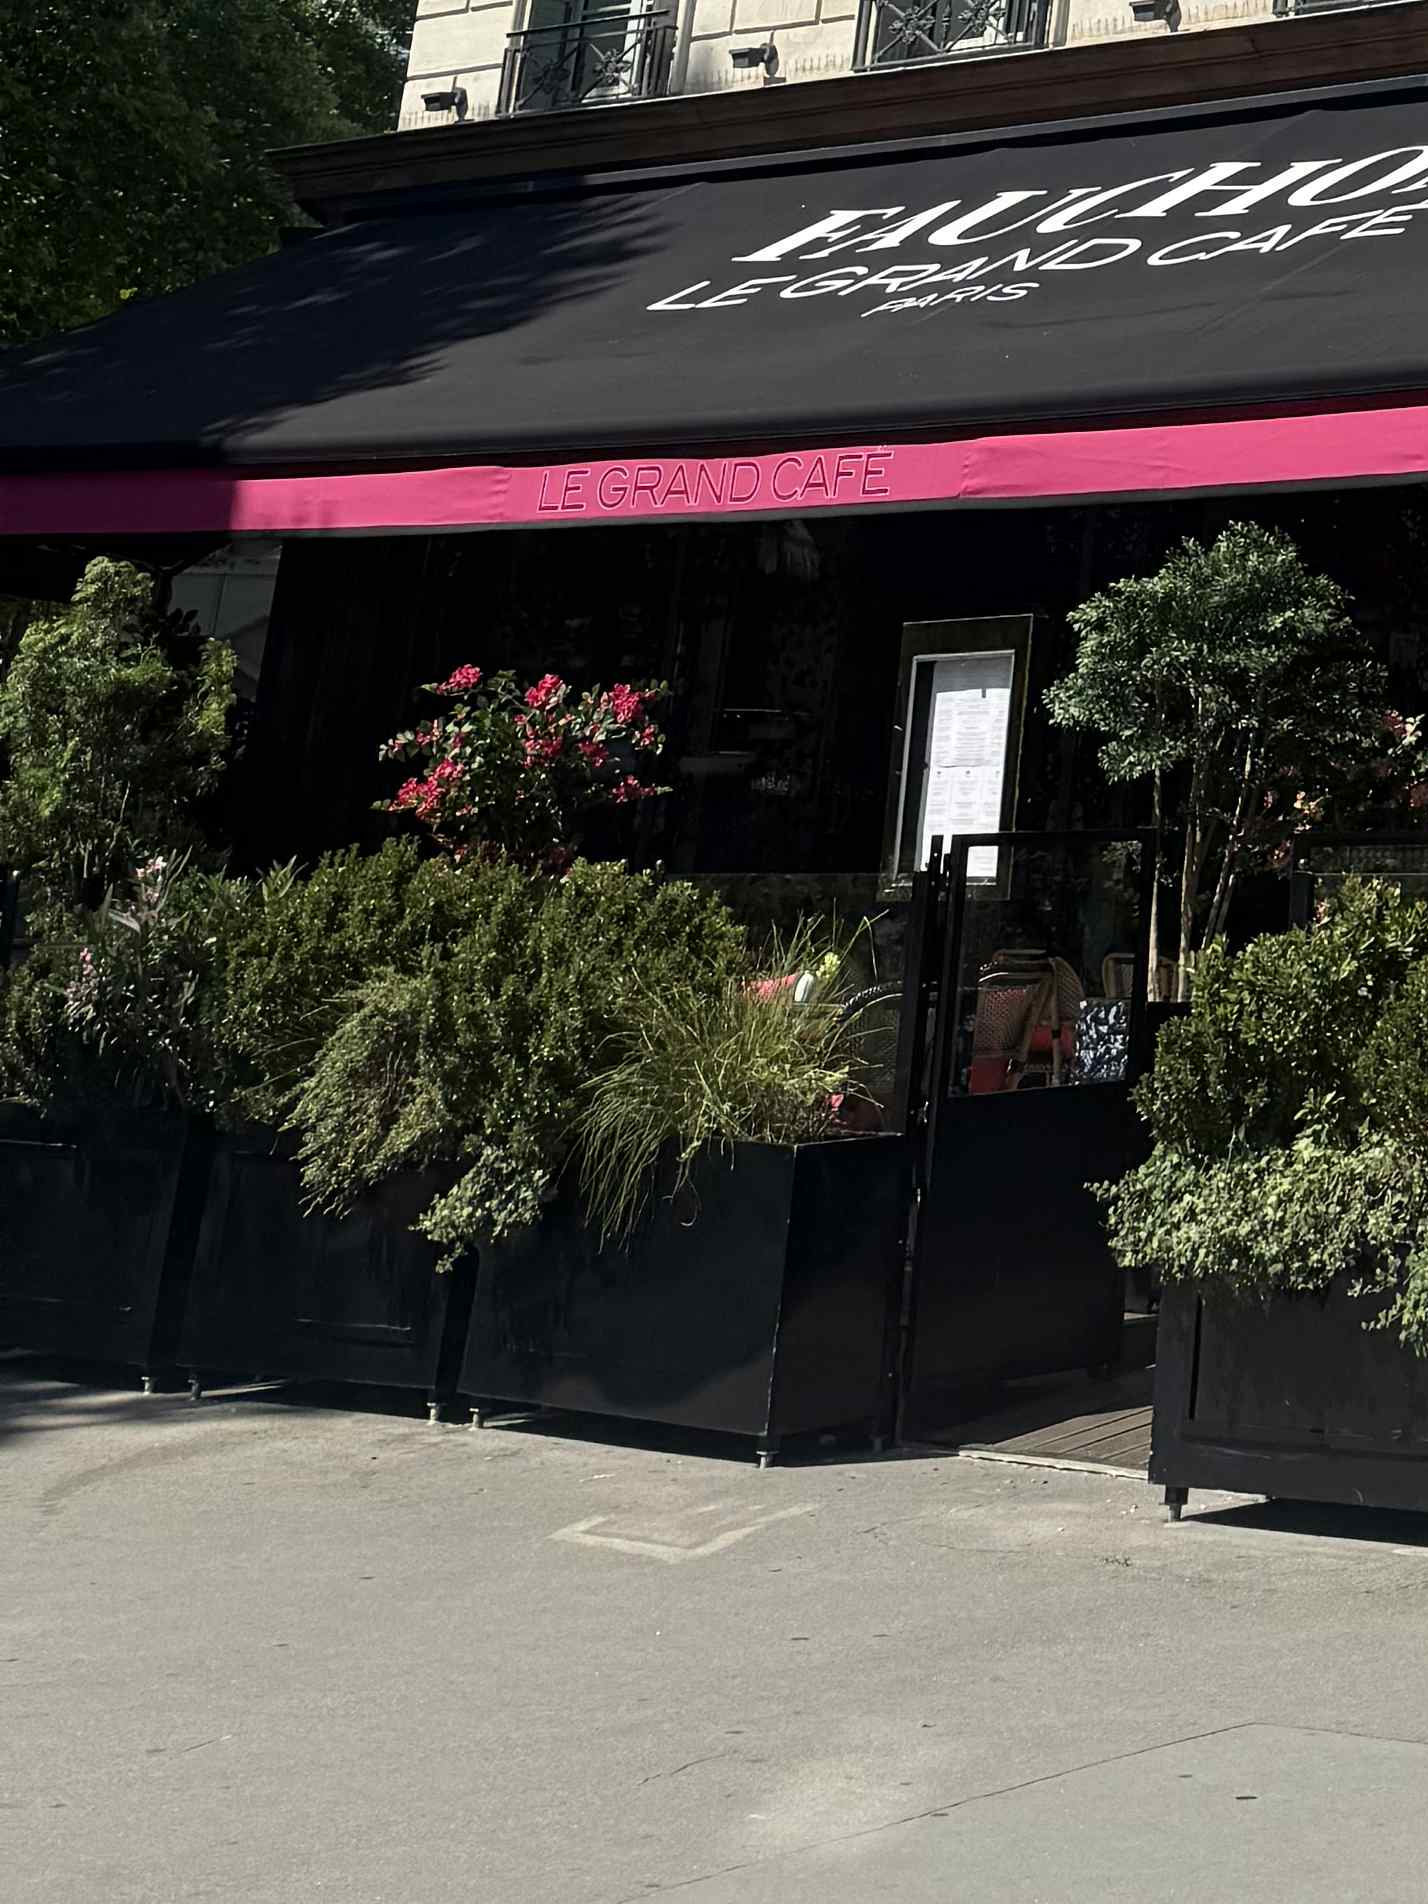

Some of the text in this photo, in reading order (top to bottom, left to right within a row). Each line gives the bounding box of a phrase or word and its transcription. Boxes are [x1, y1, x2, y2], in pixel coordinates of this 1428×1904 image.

[646, 274, 797, 310] LE
[779, 238, 1143, 299] GRAND
[860, 282, 1040, 318] PARIS
[536, 467, 592, 512] LE
[598, 461, 761, 510] GRAND
